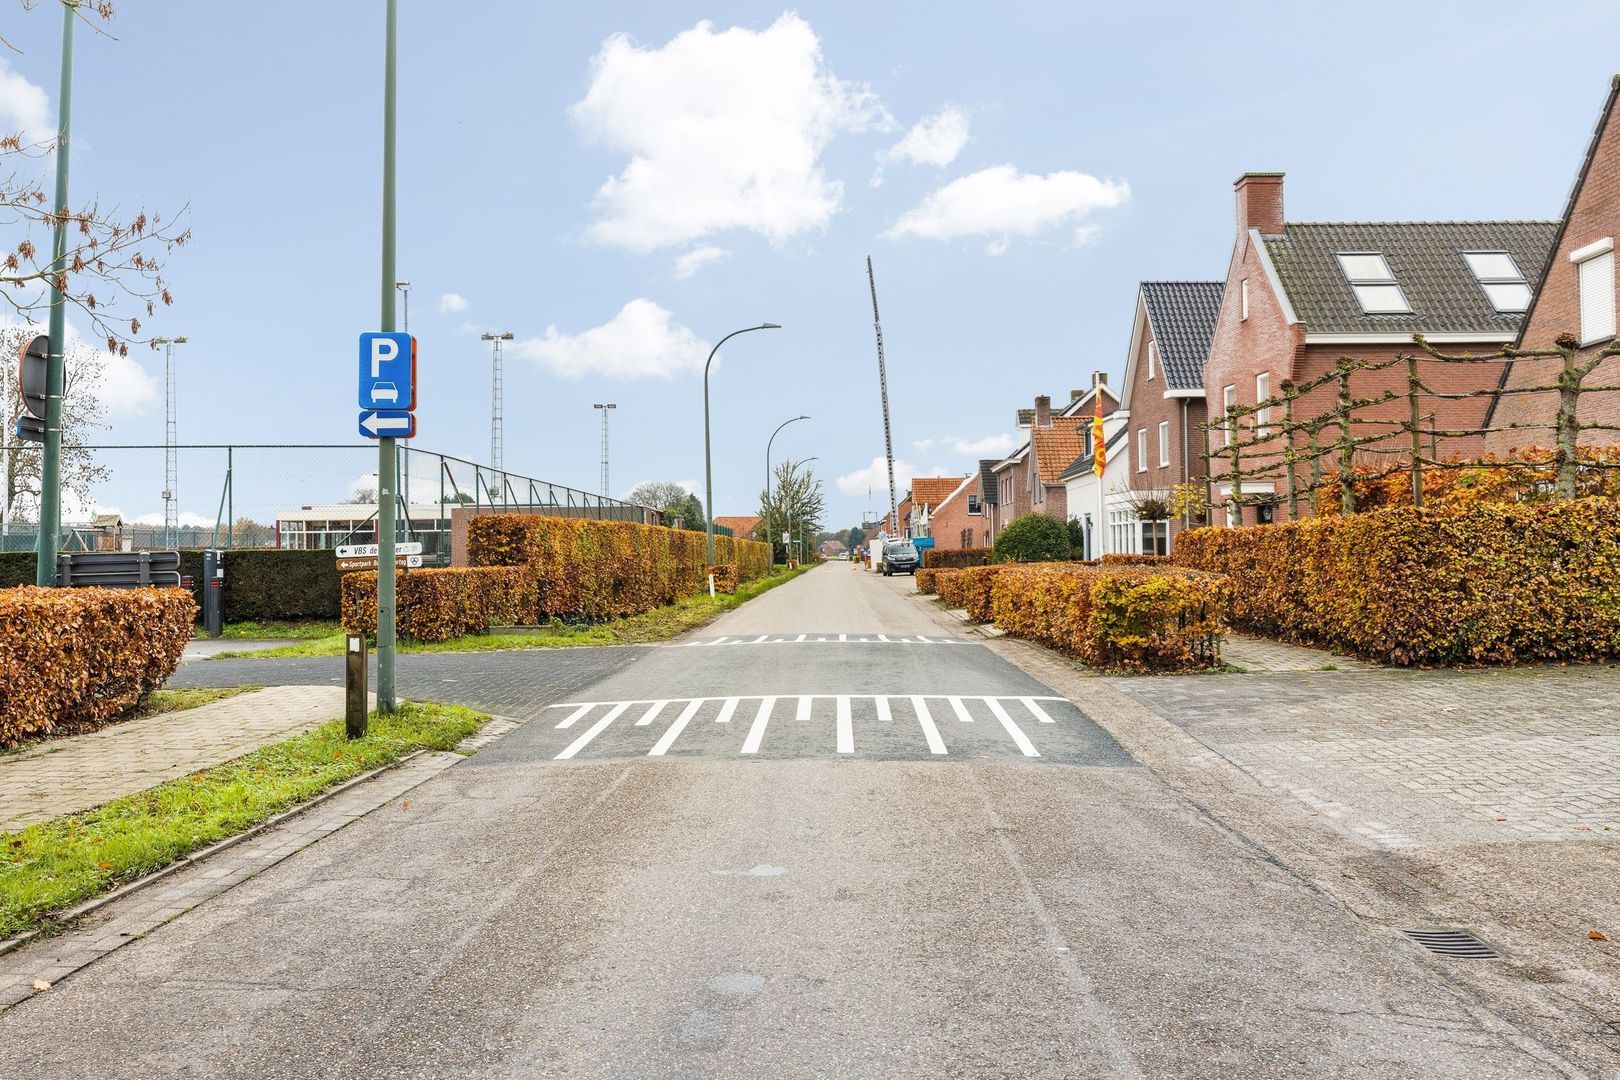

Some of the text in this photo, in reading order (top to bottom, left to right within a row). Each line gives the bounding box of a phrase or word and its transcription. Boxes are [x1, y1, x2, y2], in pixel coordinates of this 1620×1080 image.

[372, 338, 398, 378] P
[370, 546, 377, 554] de
[349, 560, 371, 568] Sportpark
